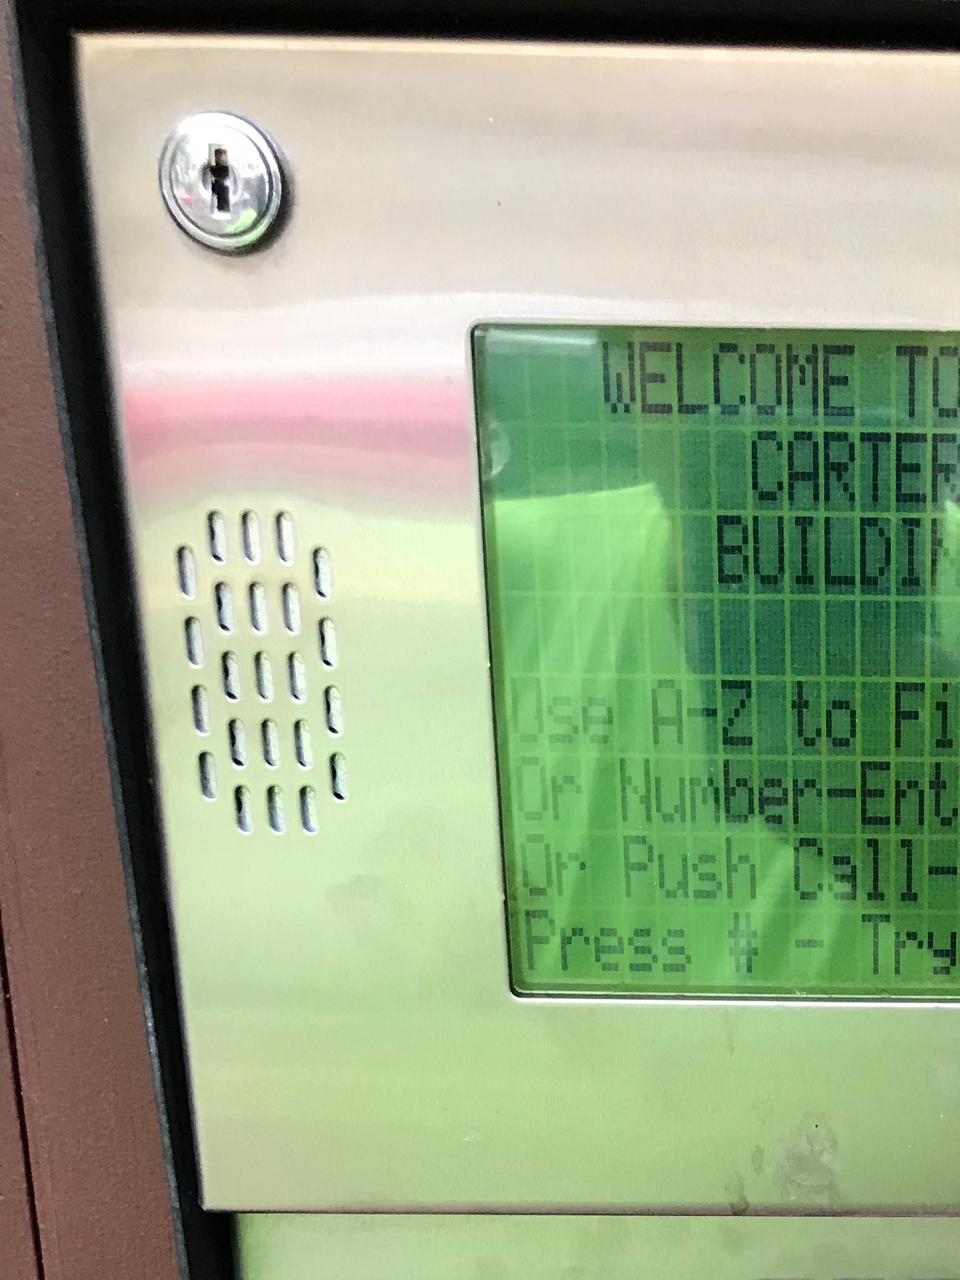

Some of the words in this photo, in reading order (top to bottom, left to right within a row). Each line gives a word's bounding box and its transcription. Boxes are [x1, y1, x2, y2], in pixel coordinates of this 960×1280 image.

[602, 340, 855, 416] WELCOME
[510, 677, 613, 744] Use
[651, 679, 753, 748] A-Z
[791, 680, 858, 749] to
[516, 756, 583, 821] Or
[520, 833, 587, 897] Or
[622, 835, 757, 901] Push
[524, 909, 692, 973] Press
[727, 912, 758, 974] #
[861, 914, 958, 976] Try
